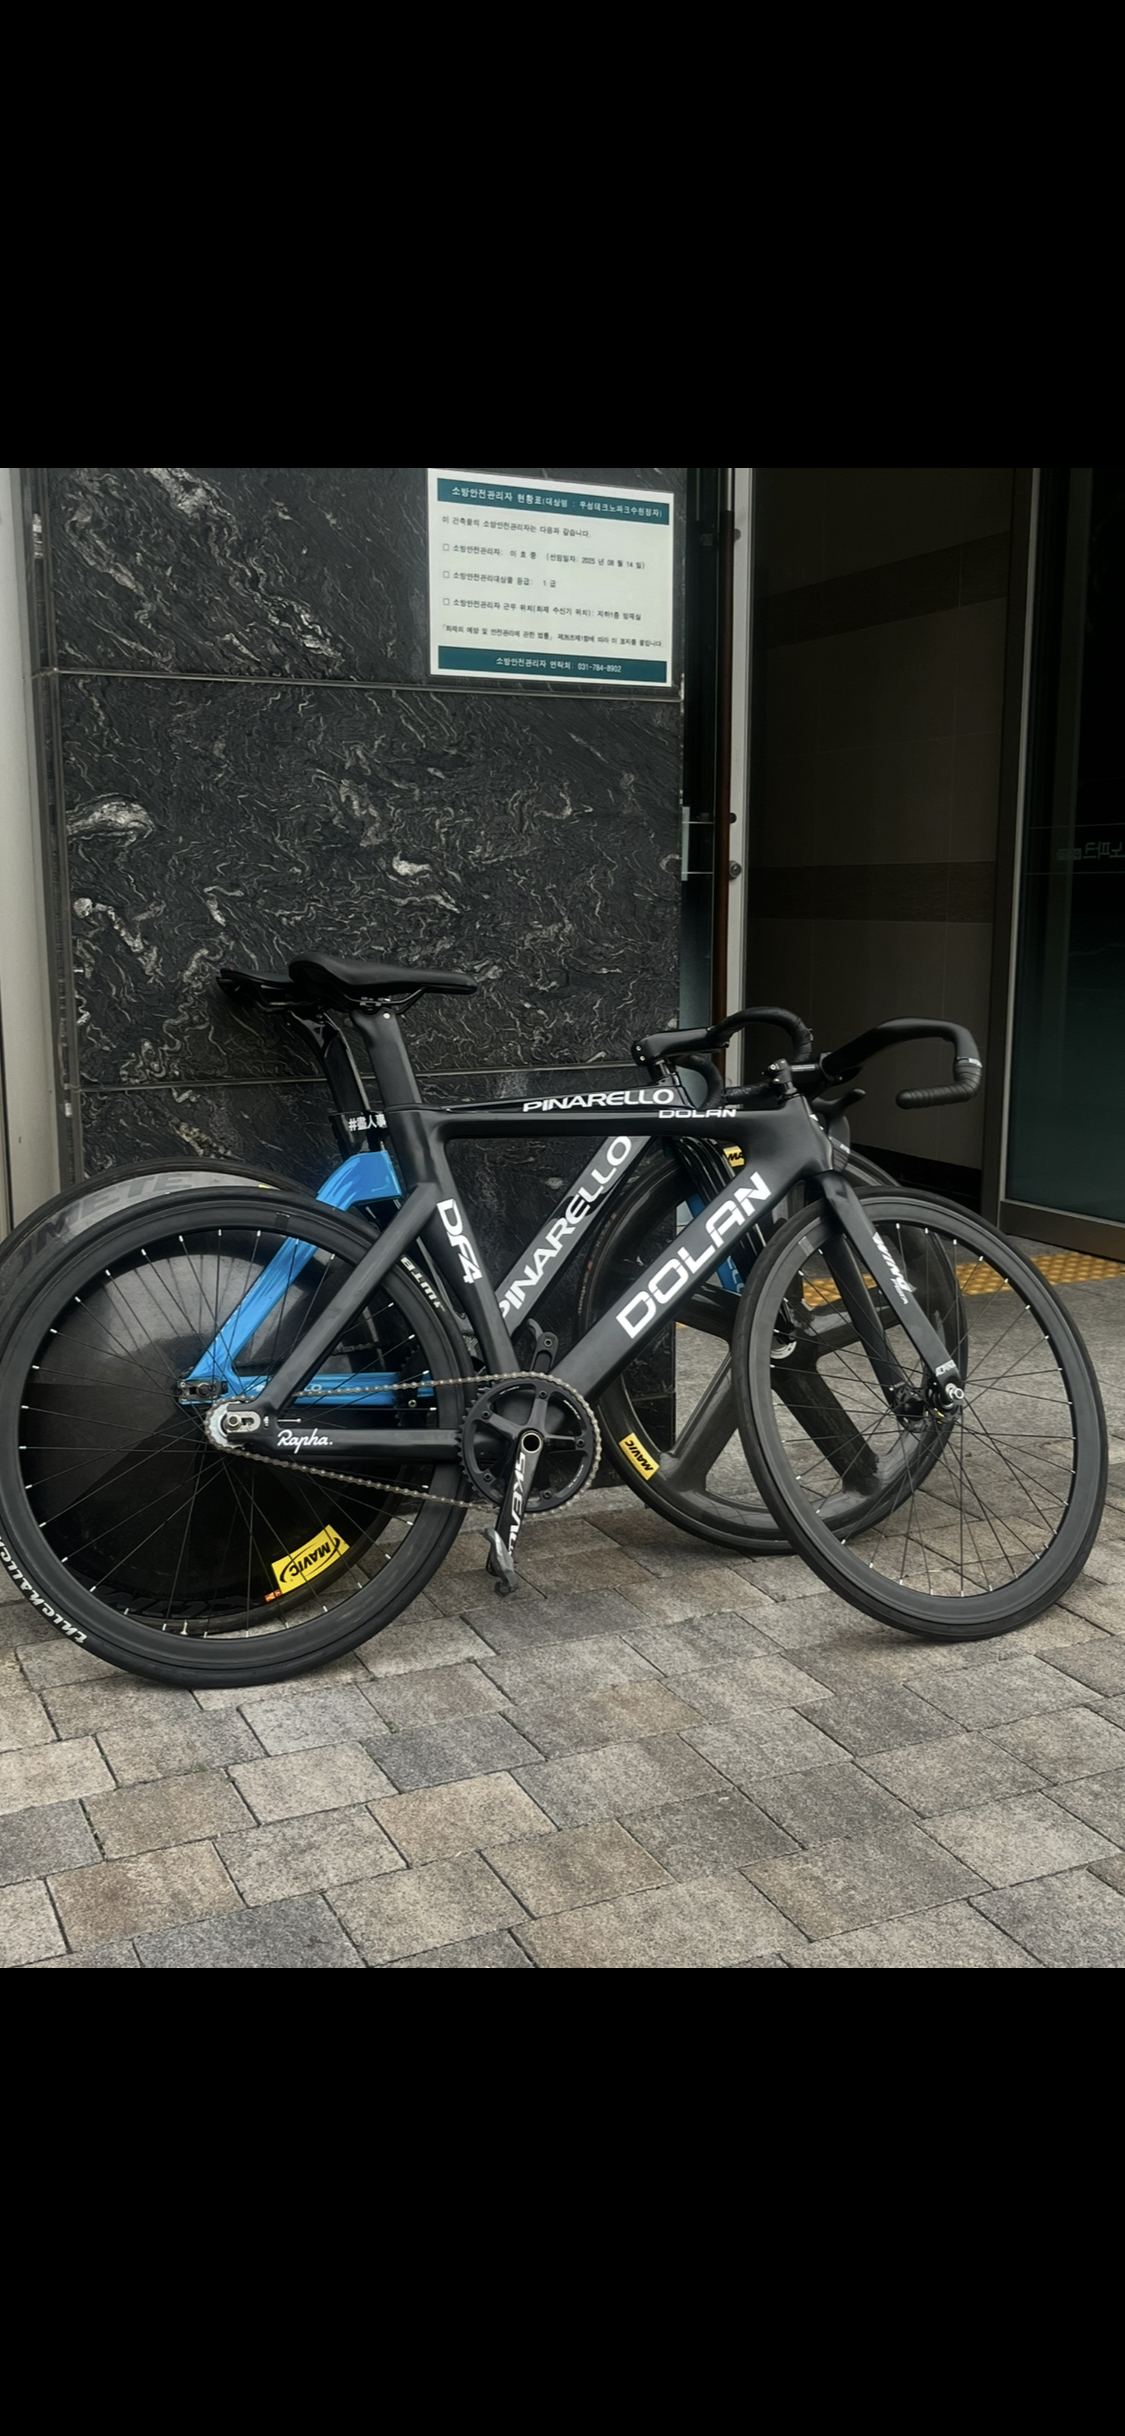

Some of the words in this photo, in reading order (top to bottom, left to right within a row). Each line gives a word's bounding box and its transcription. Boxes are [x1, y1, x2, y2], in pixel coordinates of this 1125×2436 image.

[451, 486, 513, 502] 소방안전관리자
[442, 515, 449, 524] 이
[452, 517, 480, 527] 건축물의
[483, 519, 537, 533] 소방안전관리자는
[539, 526, 560, 535] 다음과
[562, 528, 591, 538] 같습니다.
[452, 544, 503, 556] 소방안전관리자:
[452, 571, 513, 585] 소방안전관리대상물
[453, 599, 501, 611] 소방안전관리자
[503, 602, 517, 612] 근무
[552, 606, 573, 616] 수신기
[496, 657, 547, 669] 소방안전관리자
[522, 1088, 674, 1112] PINARELLO
[658, 1108, 736, 1118] DOLAN
[436, 1198, 483, 1284] DF4
[616, 1171, 772, 1339] DOLAN
[400, 1256, 438, 1301] WTB
[624, 1439, 654, 1471] MAVIC
[289, 1542, 332, 1577] MAVIC
